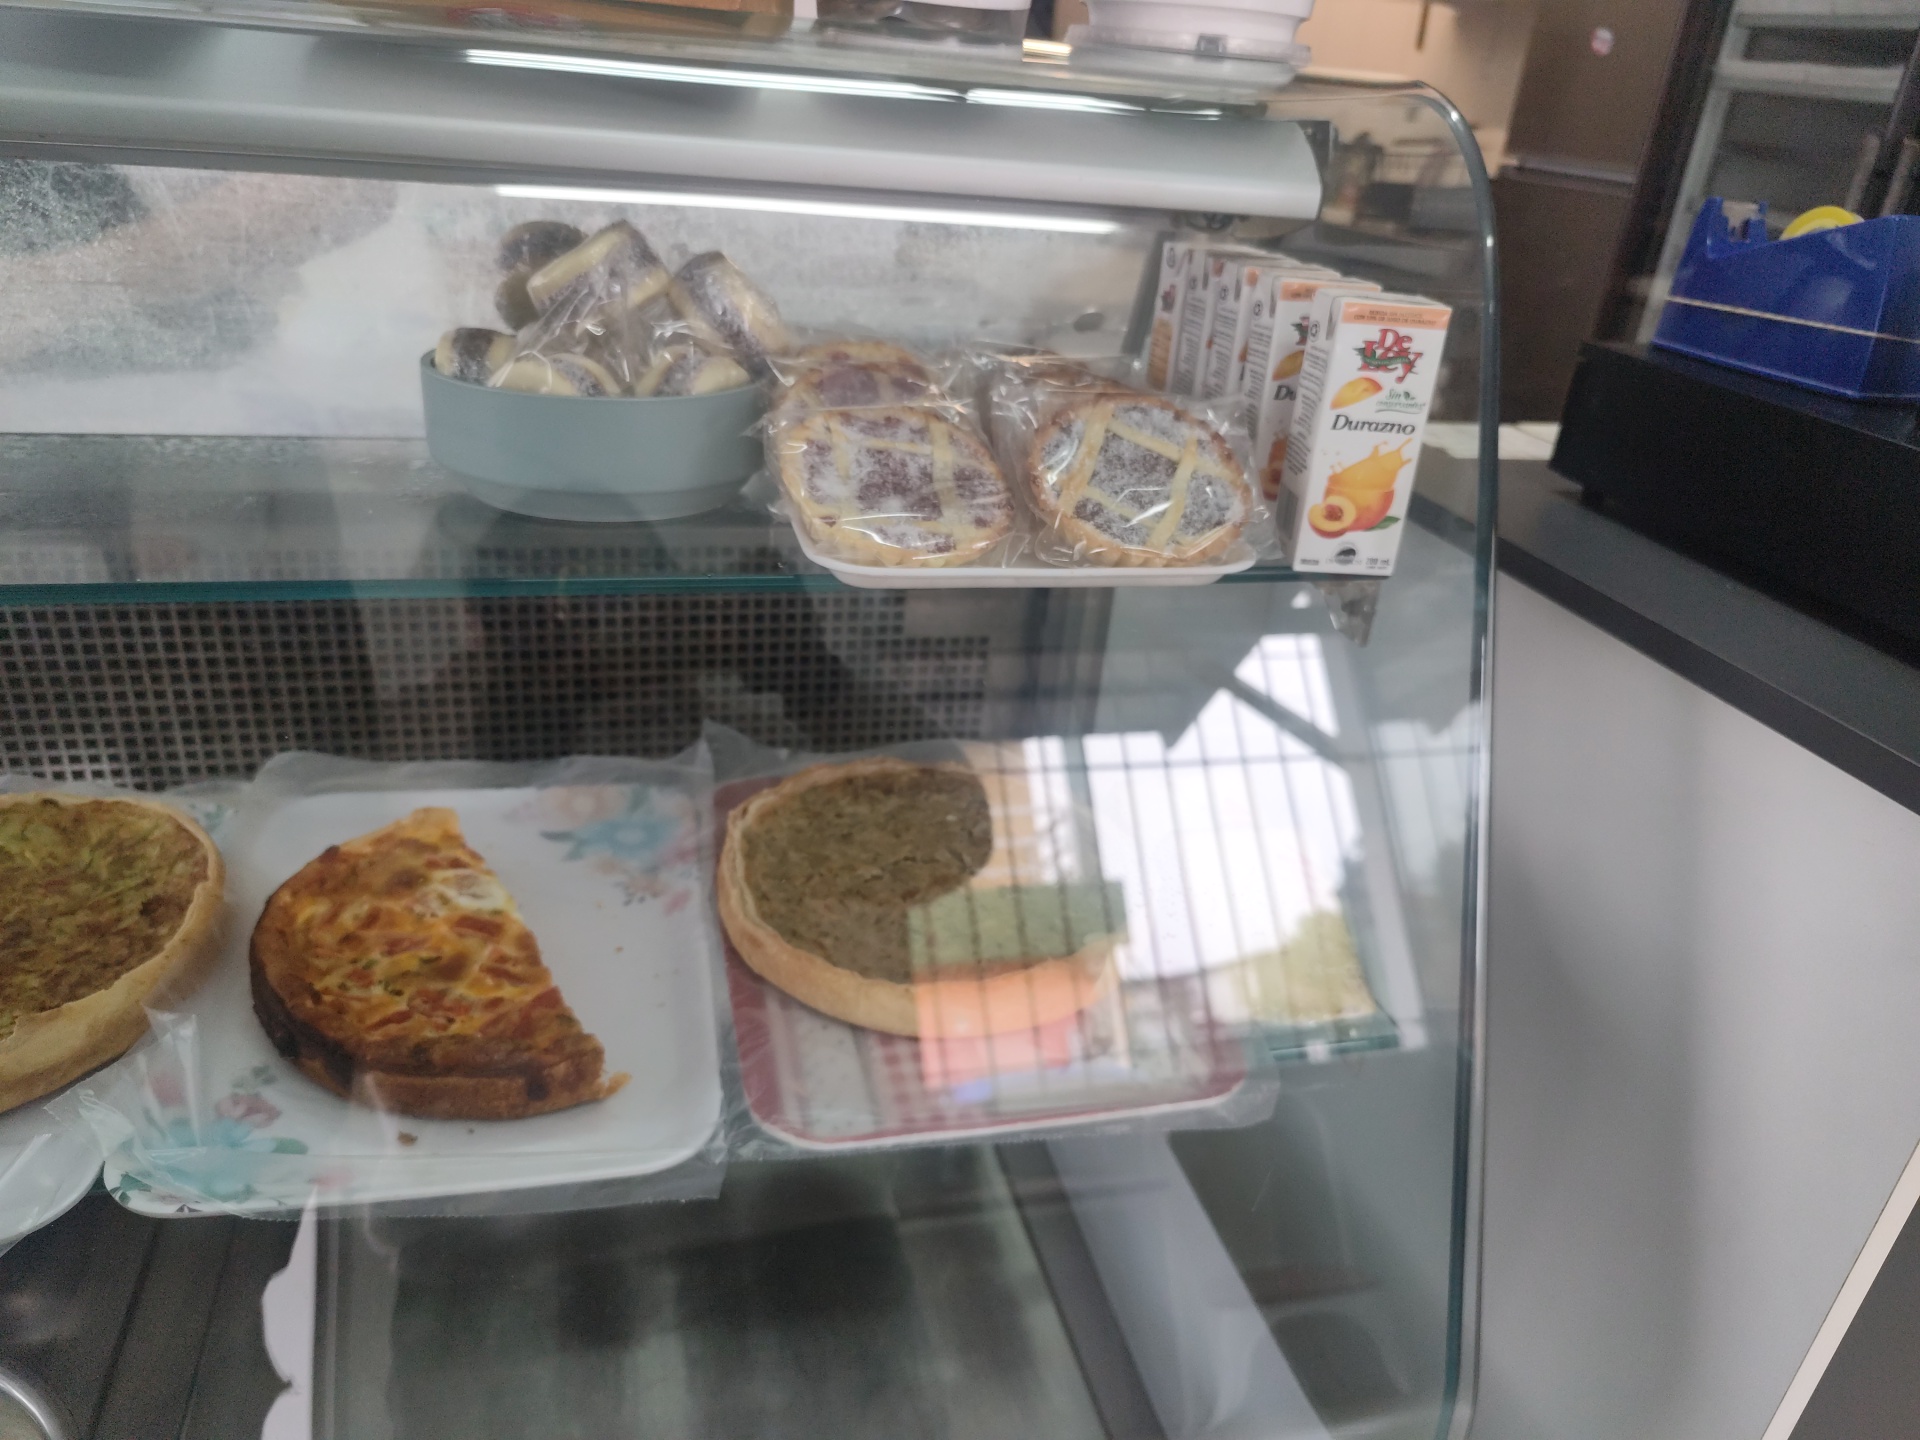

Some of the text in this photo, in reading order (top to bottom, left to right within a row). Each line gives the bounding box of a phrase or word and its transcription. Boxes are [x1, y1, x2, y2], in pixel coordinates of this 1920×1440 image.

[1376, 328, 1413, 352] De
[1386, 389, 1402, 401] Sin
[1331, 414, 1416, 436] Durazno
